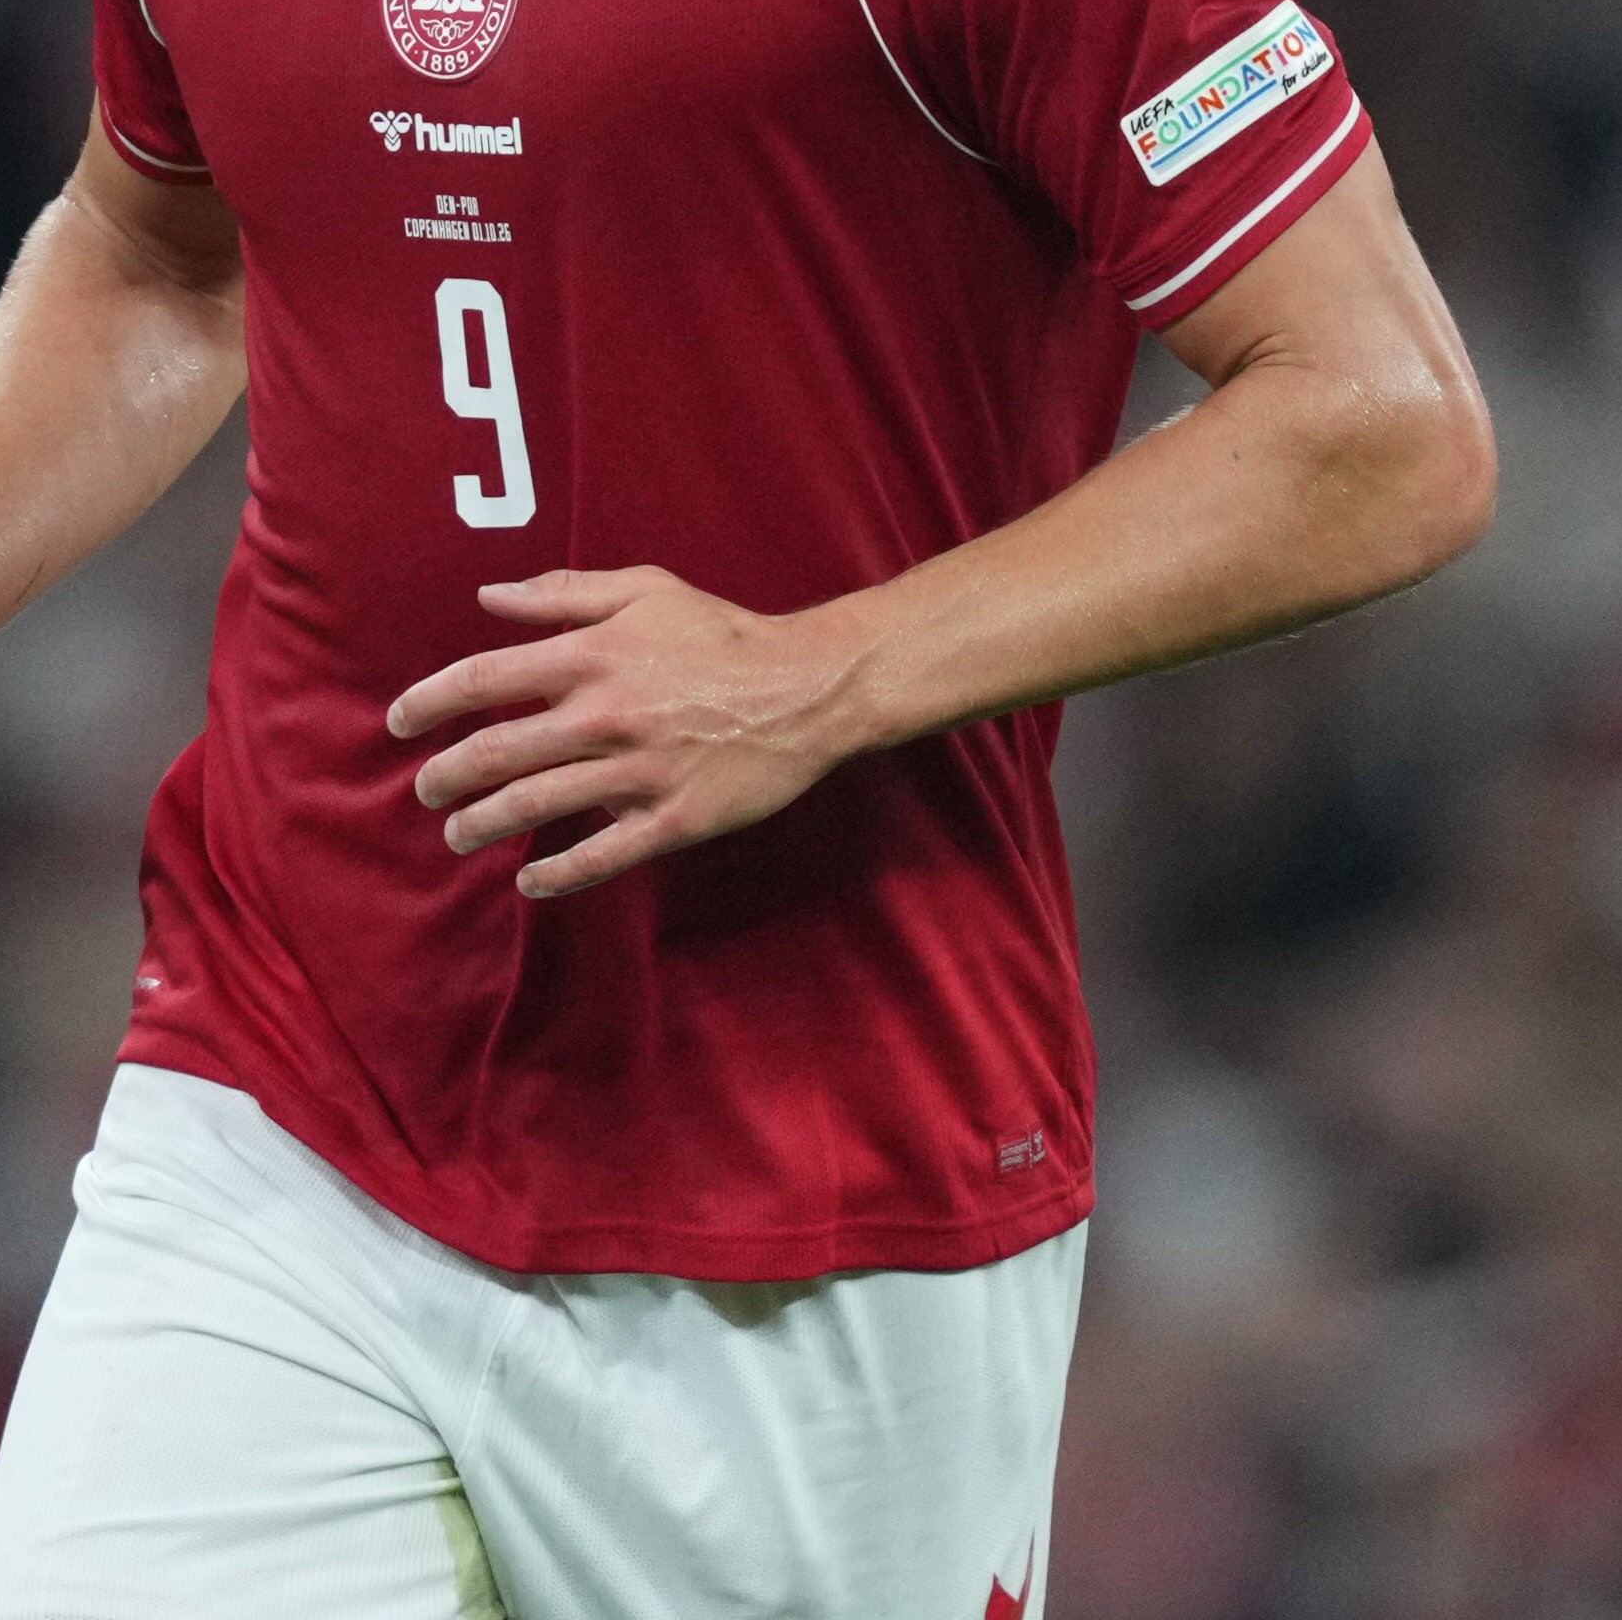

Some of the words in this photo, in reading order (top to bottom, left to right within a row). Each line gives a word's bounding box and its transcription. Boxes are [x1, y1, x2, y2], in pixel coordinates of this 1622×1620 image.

[419, 50, 469, 72] 1889
[1281, 73, 1297, 95] for
[1130, 97, 1175, 136] UEFA
[414, 113, 523, 155] hummel
[435, 194, 479, 216] DEN-POR
[404, 217, 470, 240] COPENHAGEN
[435, 278, 537, 528] 9
